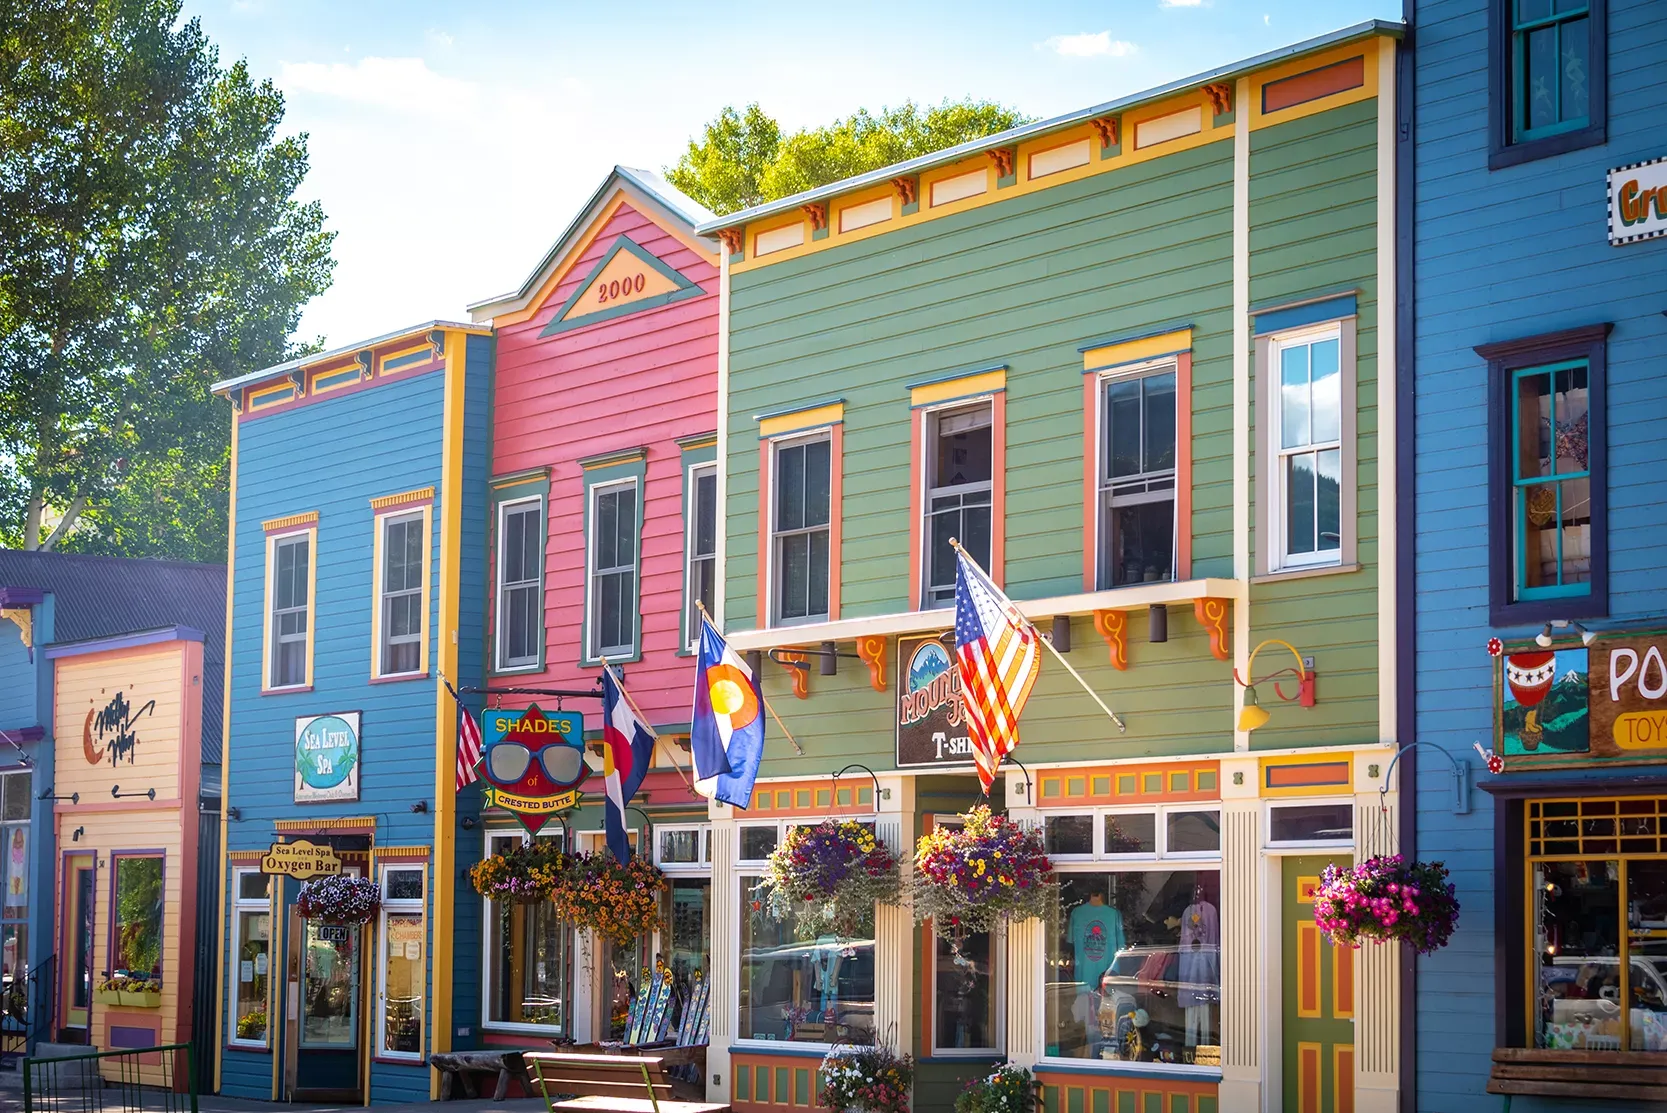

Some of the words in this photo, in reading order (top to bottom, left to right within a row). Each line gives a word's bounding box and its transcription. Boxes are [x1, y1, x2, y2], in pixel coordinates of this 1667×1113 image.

[598, 272, 646, 304] 2000
[1610, 645, 1667, 702] PO
[496, 718, 571, 733] SHADES
[1624, 715, 1667, 743] TOY
[527, 775, 539, 787] of
[498, 796, 541, 809] CRESTED
[542, 796, 572, 809] BUTTE
[276, 846, 290, 855] Sea
[292, 847, 313, 856] Level
[315, 848, 331, 858] Spa
[266, 857, 311, 872] Oxygen
[315, 859, 338, 872] Bar
[322, 927, 346, 940] OPEN
